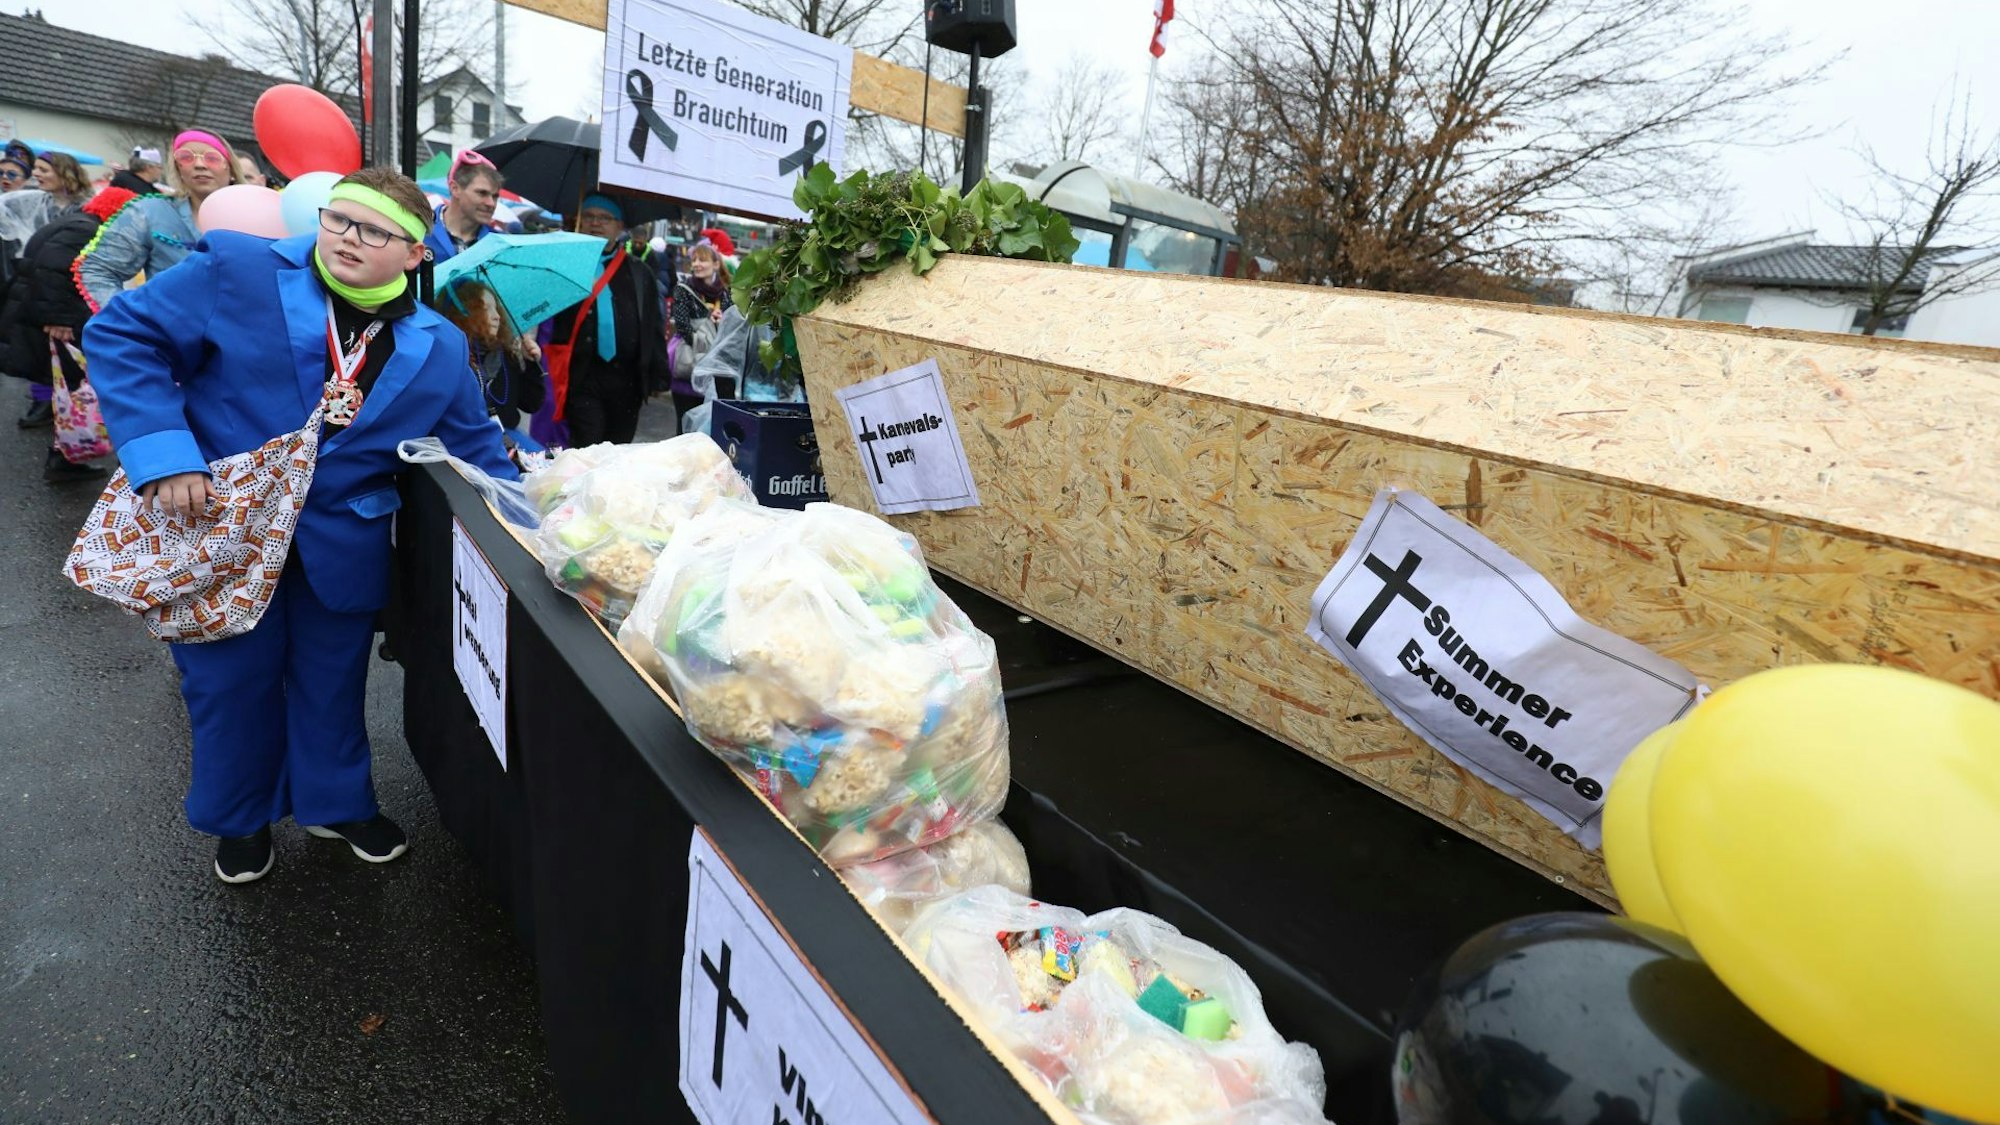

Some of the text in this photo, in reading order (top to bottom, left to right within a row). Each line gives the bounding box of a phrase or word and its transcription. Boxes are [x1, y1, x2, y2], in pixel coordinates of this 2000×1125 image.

[638, 32, 823, 112] Letzte Generation
[673, 88, 788, 144] Brauchtum
[768, 474, 816, 496] Gaffel
[1423, 604, 1573, 729] Summer
[1397, 638, 1604, 802] Experience
